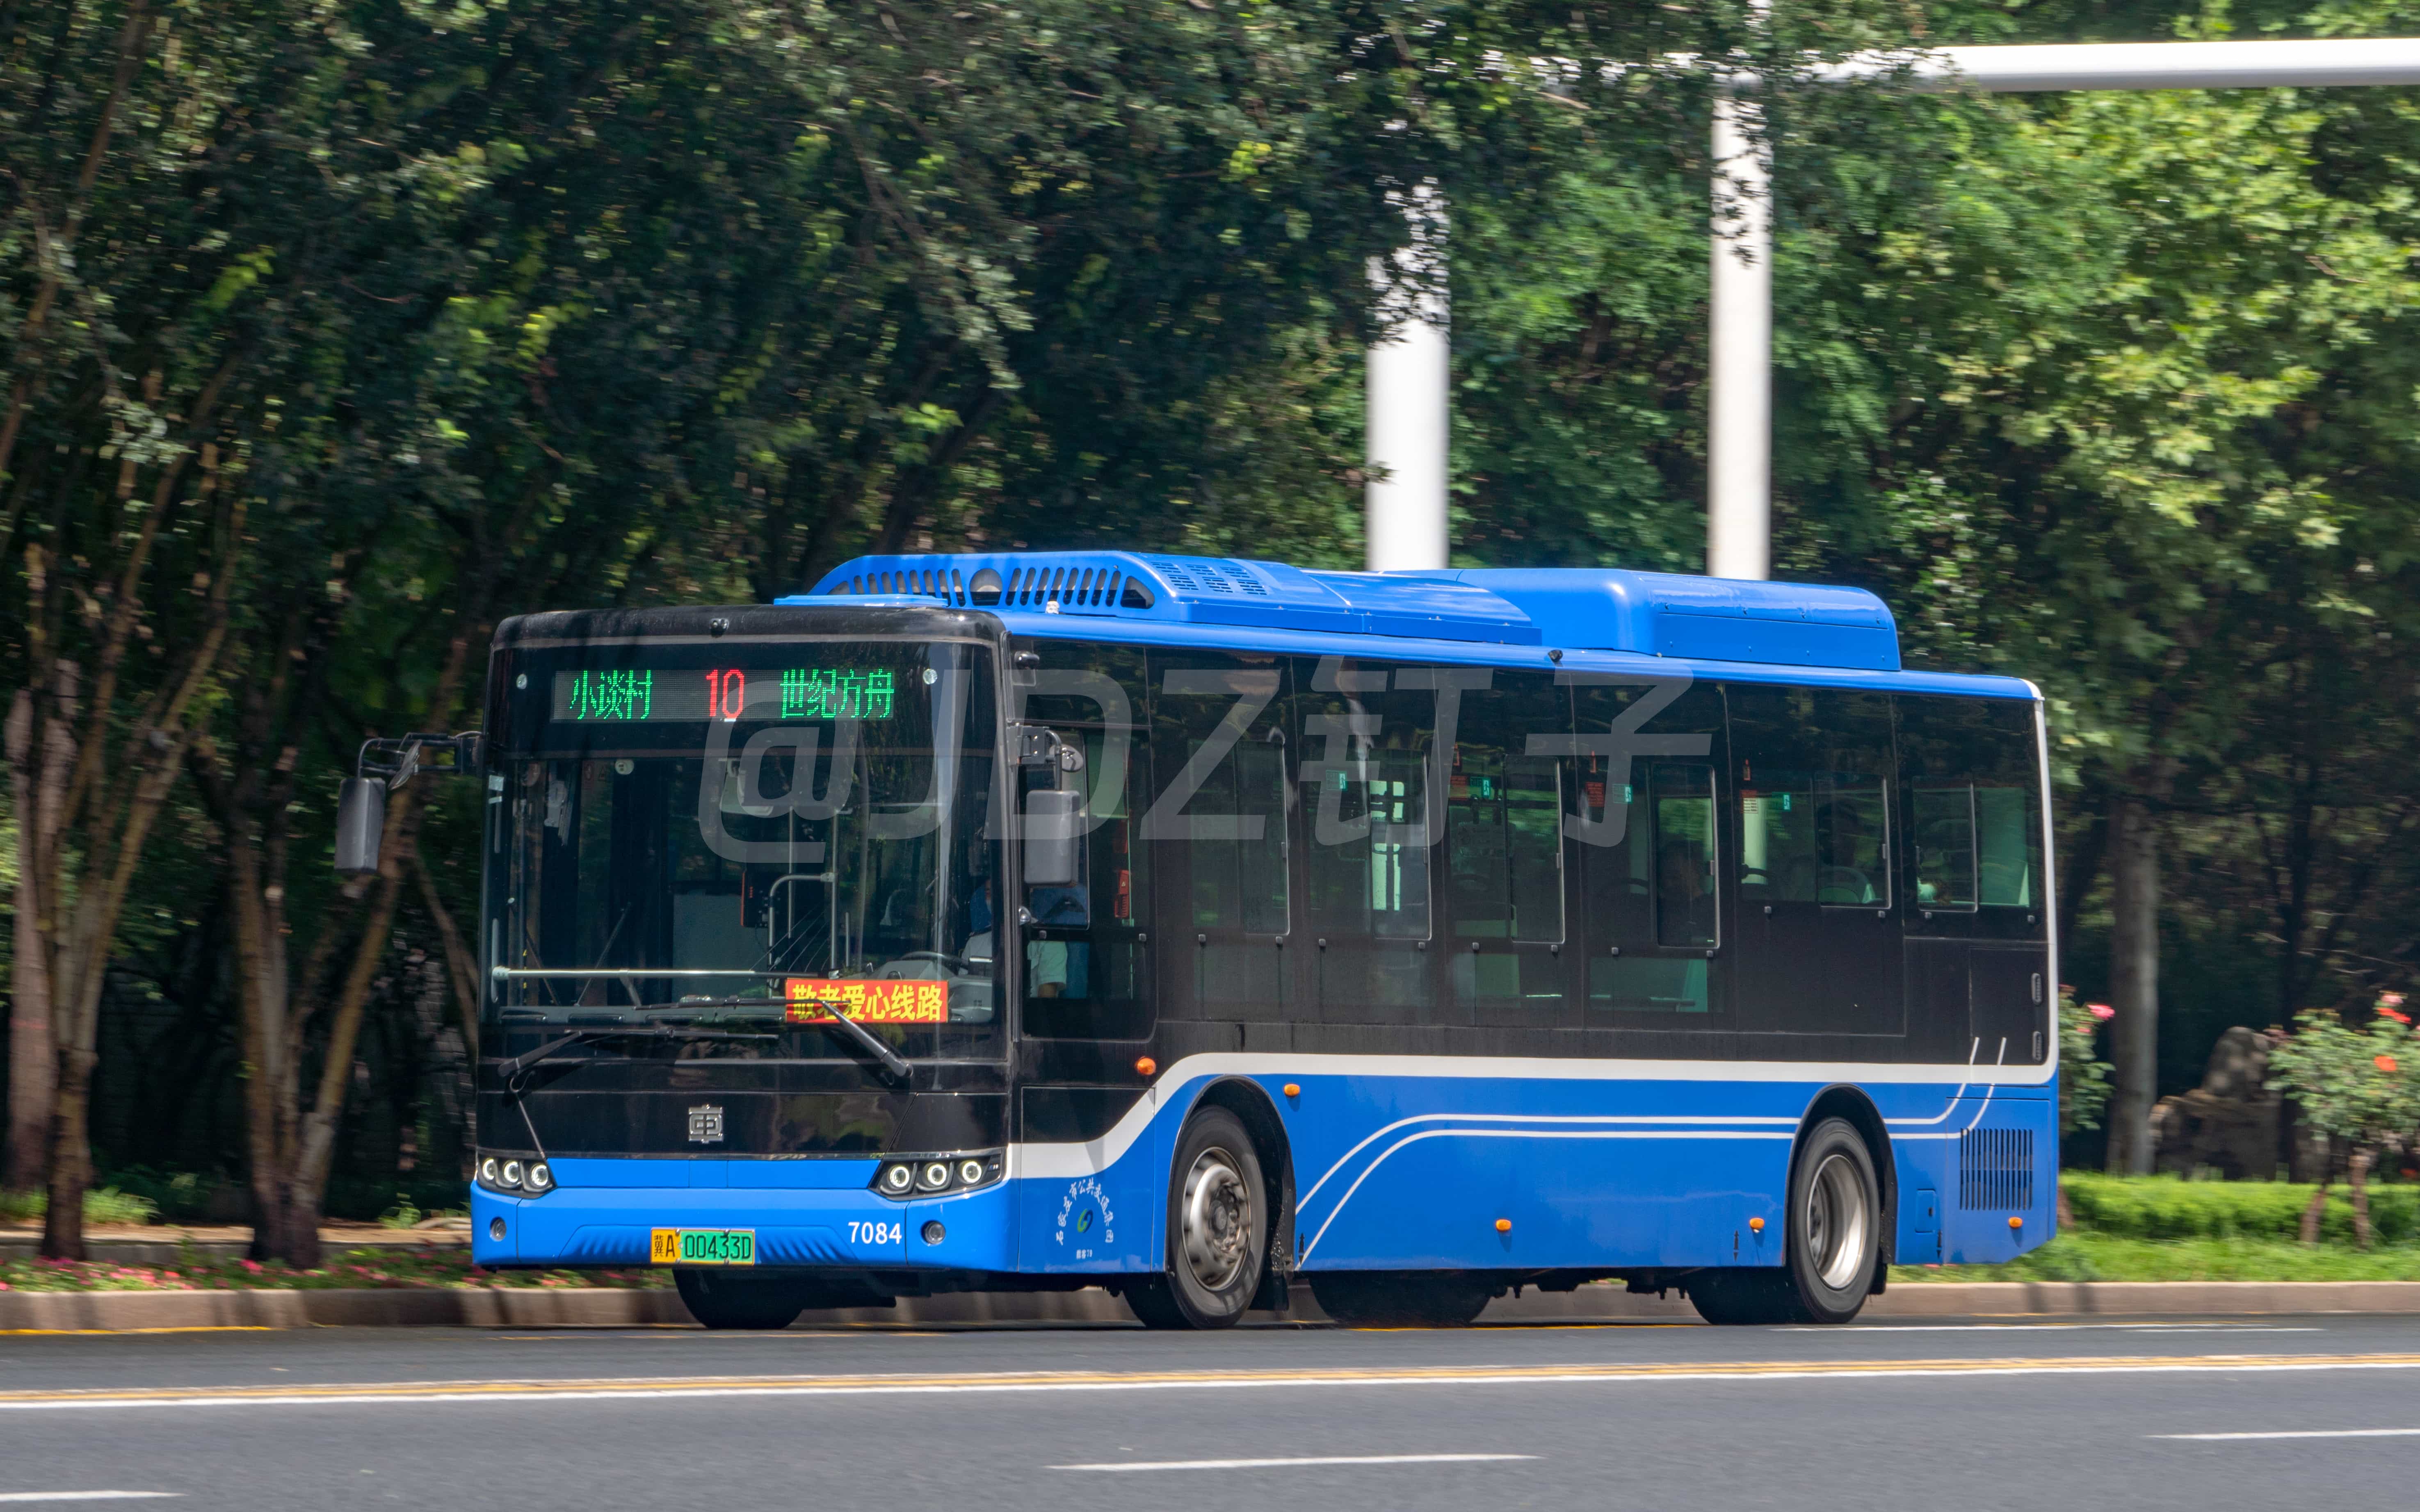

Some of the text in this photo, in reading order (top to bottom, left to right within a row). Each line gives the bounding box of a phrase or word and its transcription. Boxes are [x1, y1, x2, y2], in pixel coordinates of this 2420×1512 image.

[569, 669, 894, 719] 小谈村 10 世纪方舟
[792, 984, 943, 1020] 敬老爱心线路
[847, 1222, 902, 1244] 7084
